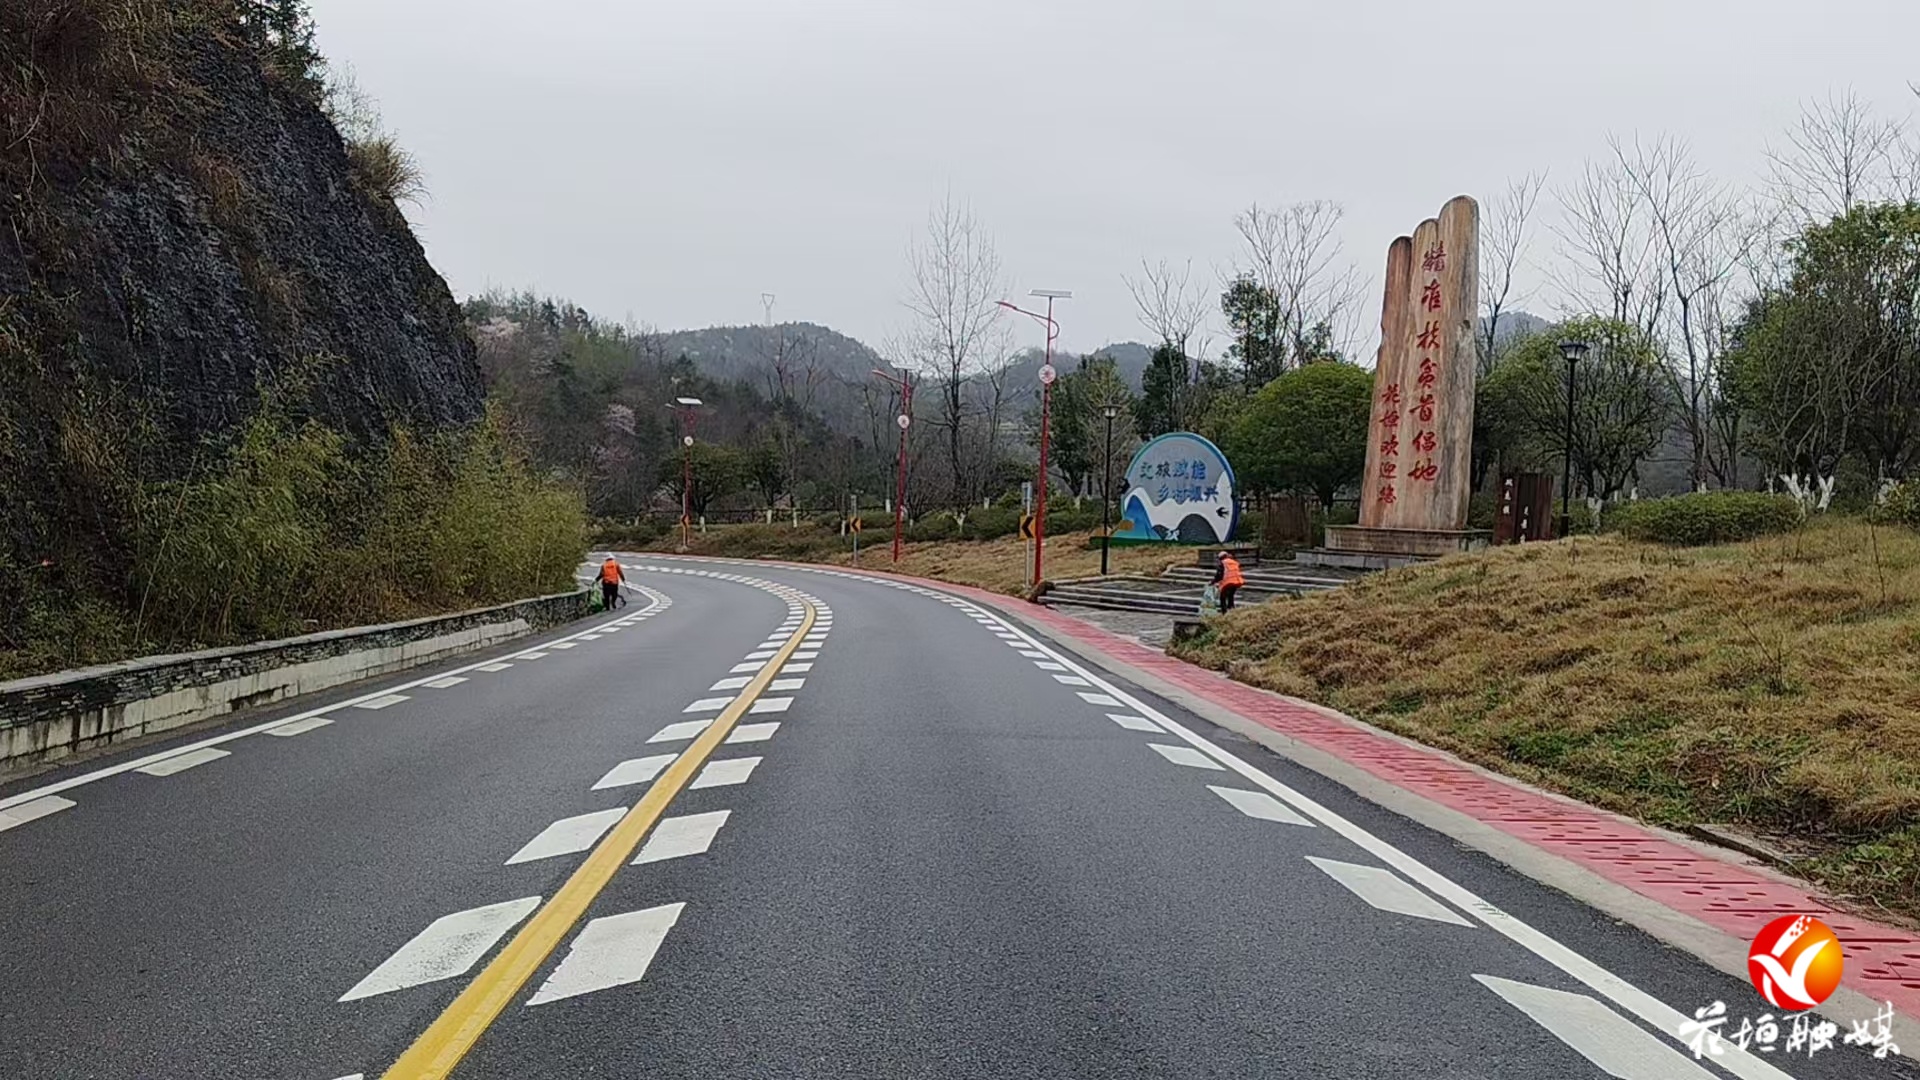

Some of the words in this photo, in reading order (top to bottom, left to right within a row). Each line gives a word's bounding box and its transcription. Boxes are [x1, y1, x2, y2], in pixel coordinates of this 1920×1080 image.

[1377, 384, 1402, 503] 花垣欢迎您
[1407, 240, 1447, 482] 精准扶贫首倡地
